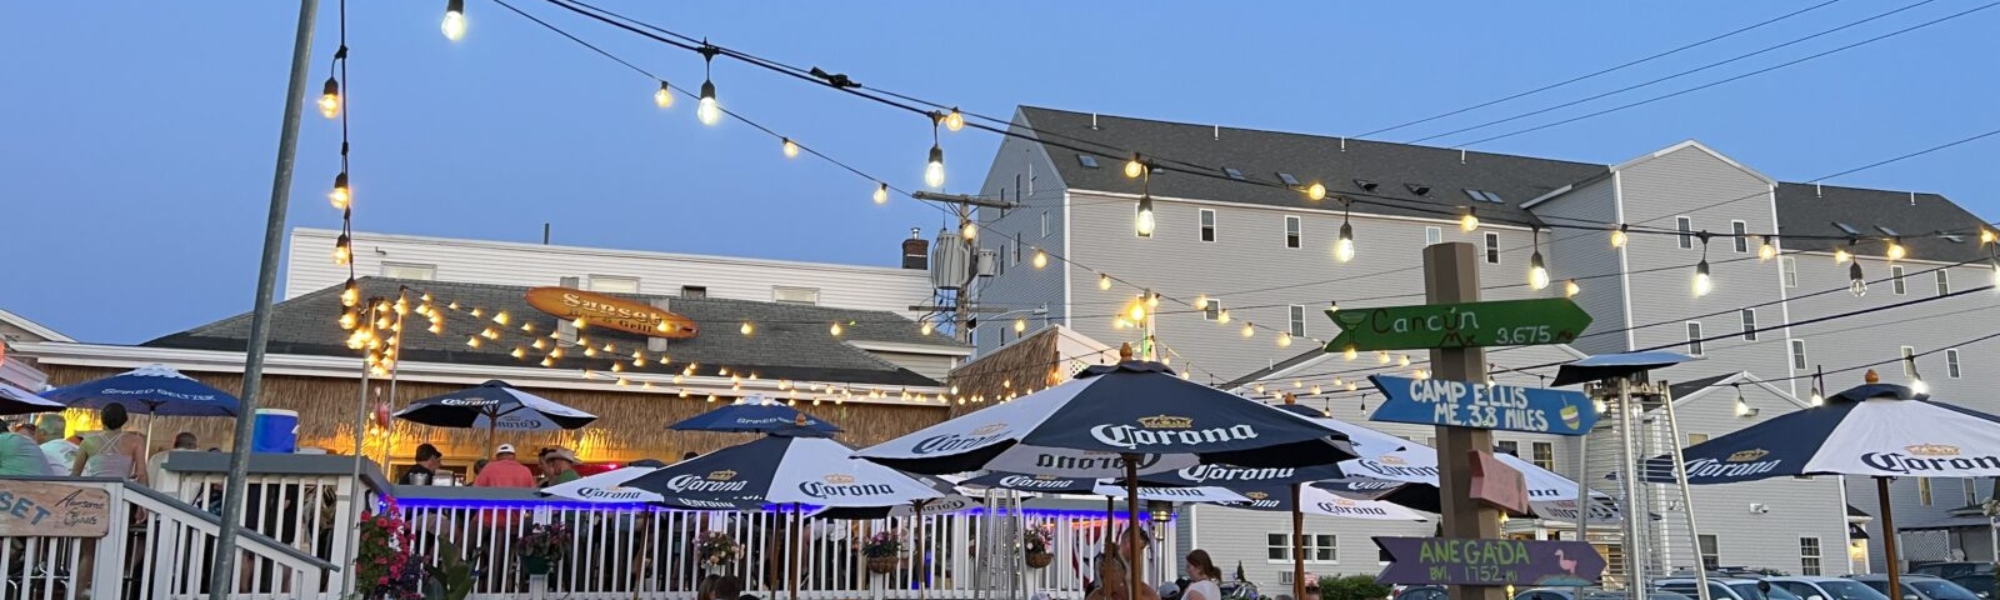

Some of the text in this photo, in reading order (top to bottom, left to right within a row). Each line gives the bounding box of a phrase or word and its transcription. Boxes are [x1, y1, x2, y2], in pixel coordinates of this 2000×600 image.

[562, 292, 663, 327] Sunset
[618, 318, 653, 334] Grill
[1371, 306, 1480, 335] Cancún
[1409, 379, 1529, 410] CAMP ELLIS
[1504, 407, 1550, 432] MILES
[1090, 423, 1259, 450] Corona
[1177, 463, 1295, 483] Corona
[1670, 458, 1782, 478] Corona
[1860, 451, 2000, 475] Coron
[666, 473, 749, 494] Corona
[798, 480, 895, 499] Corona
[999, 475, 1075, 489] Corona
[1121, 485, 1206, 498] orona
[576, 486, 642, 499] Corona
[1317, 501, 1387, 517] Corona
[1419, 540, 1531, 566] ANEGADA
